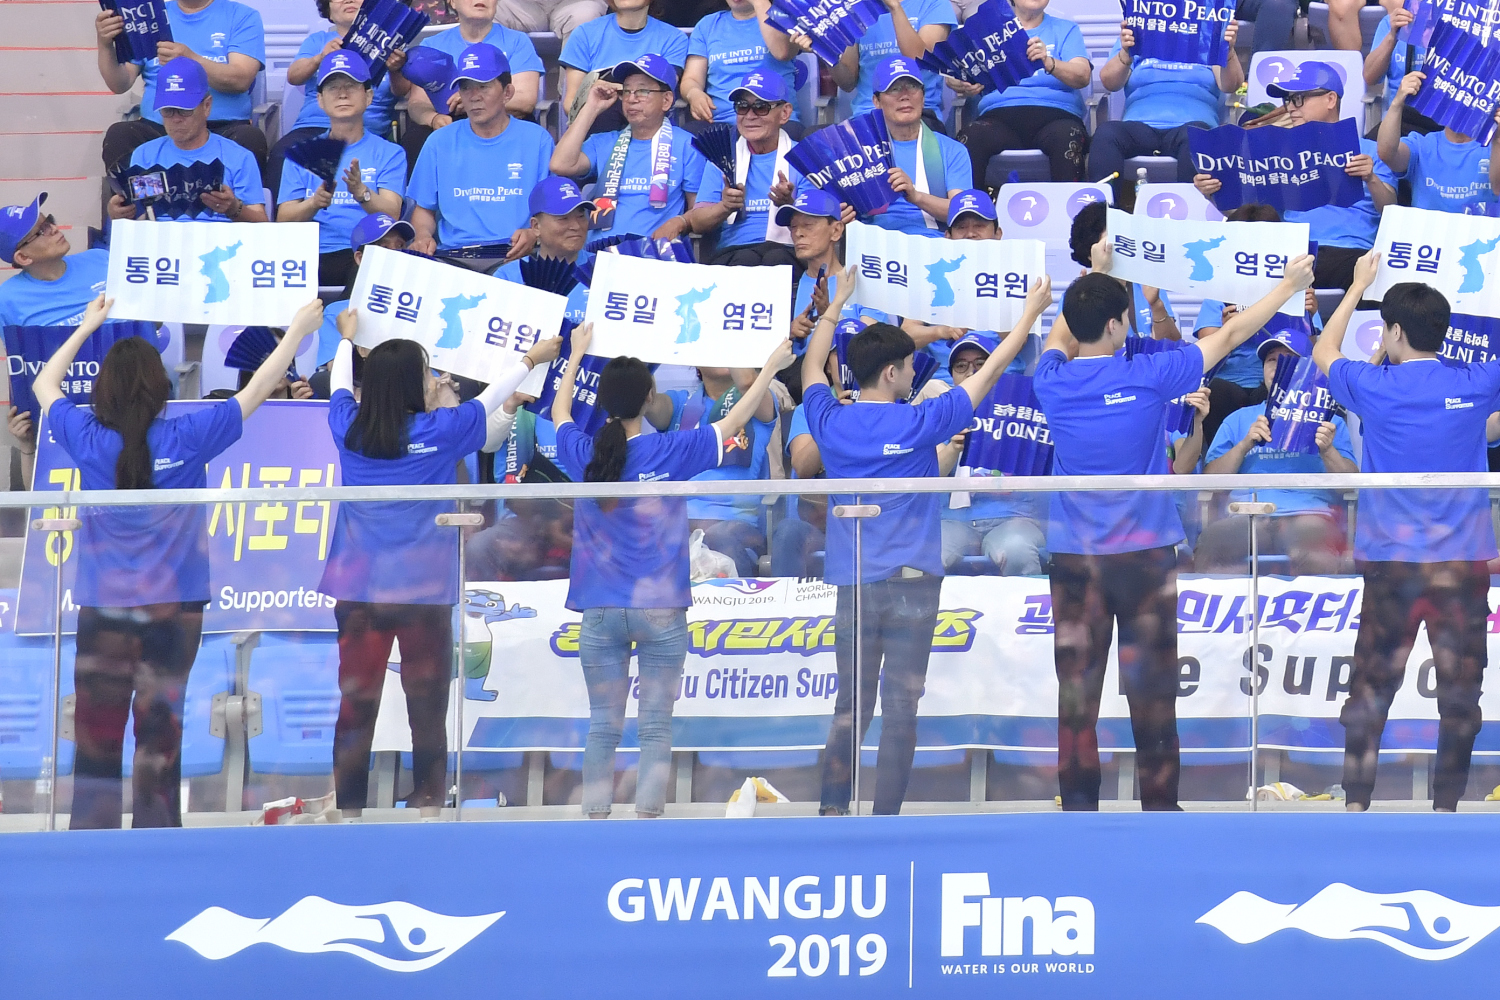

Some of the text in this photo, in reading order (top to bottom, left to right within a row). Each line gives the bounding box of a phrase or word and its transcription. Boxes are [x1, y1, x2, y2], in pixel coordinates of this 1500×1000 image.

[1197, 153, 1246, 176] DIVE
[1248, 156, 1293, 173] INTO
[1239, 170, 1320, 186] 평화의 물결 속으로
[453, 188, 472, 198] DIVE
[473, 187, 495, 196] INTO
[1114, 235, 1287, 278] 통일 염원
[1388, 242, 1441, 273] 통일
[126, 257, 306, 288] 통일 염원
[861, 254, 1027, 299] 통일 염원
[367, 284, 541, 353] 통일 염원
[605, 292, 772, 330] 통일 염원
[219, 584, 337, 610] Supporters
[693, 595, 746, 606] WANGJU
[705, 668, 789, 699] Citizen
[607, 875, 886, 922] GWANGJU
[767, 933, 887, 977] 2019
[941, 963, 1095, 975] WATER IS OUR WORLD
